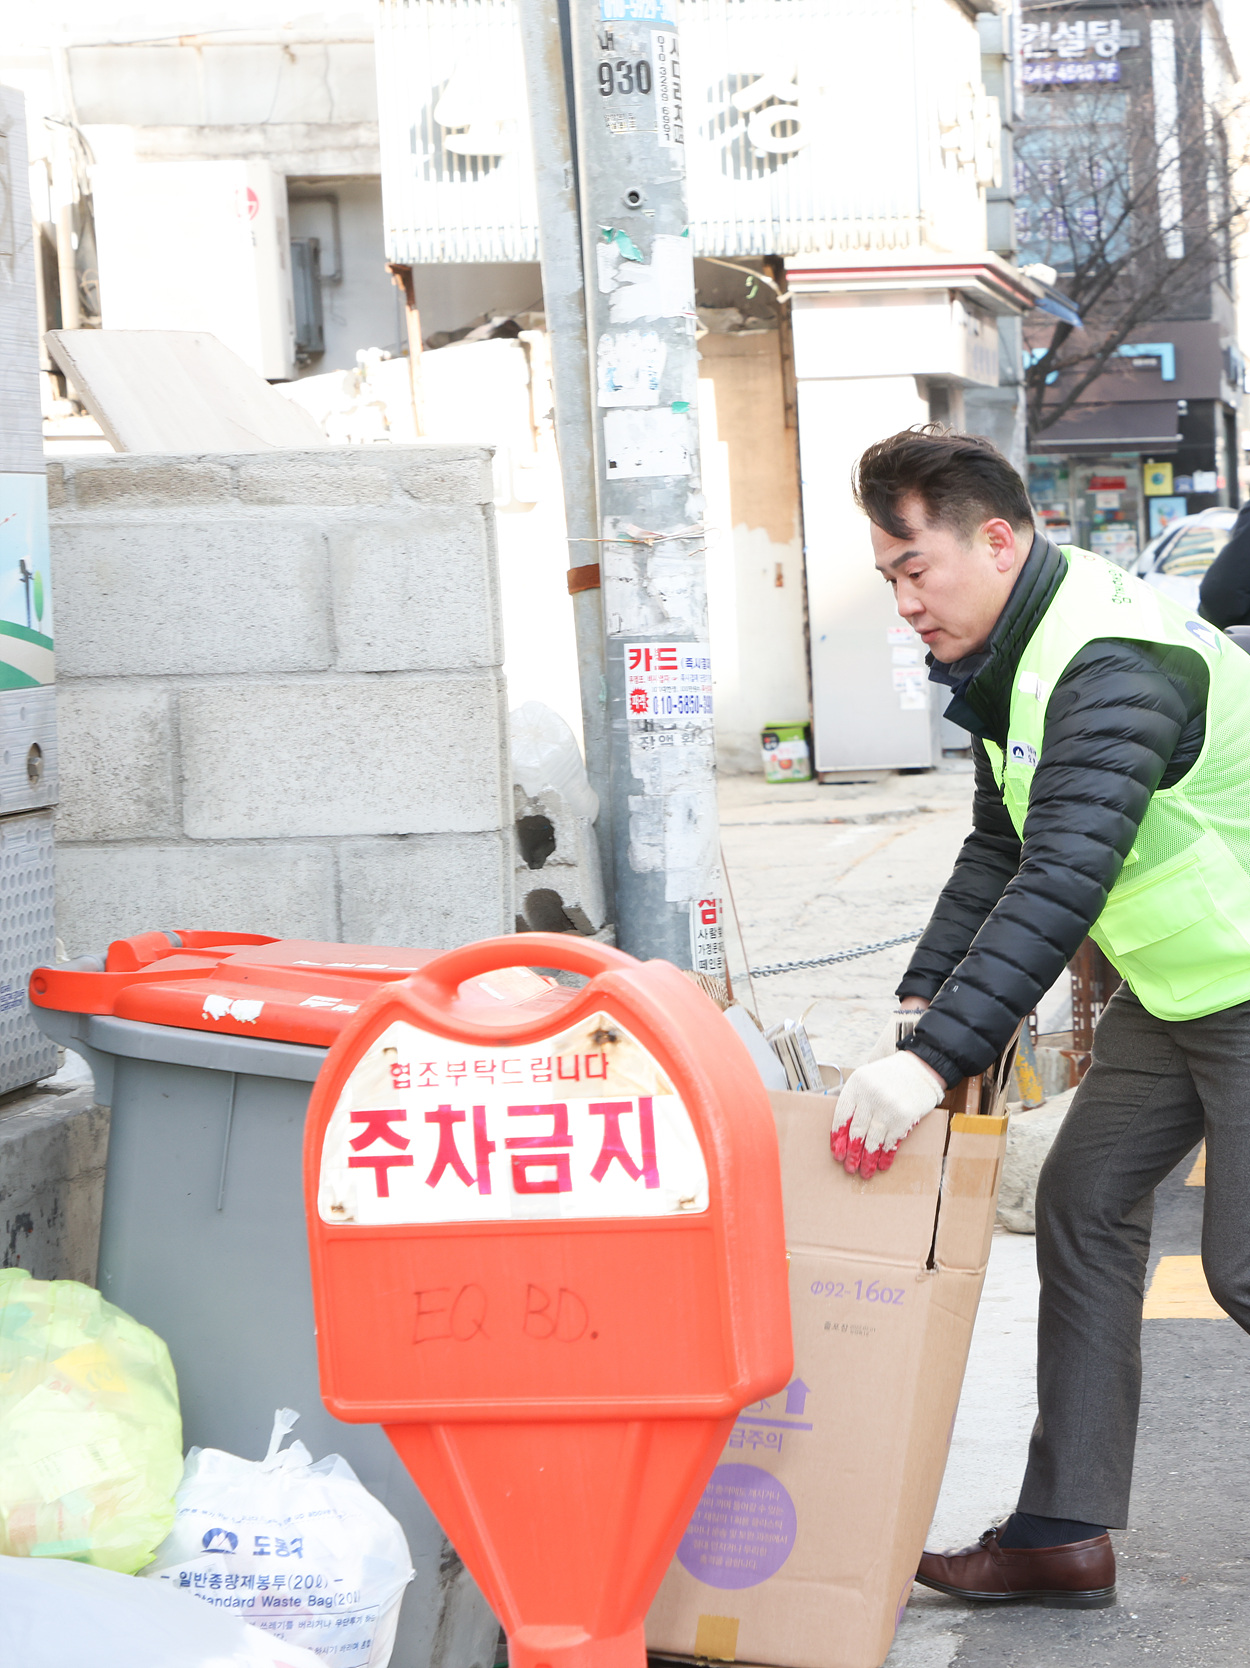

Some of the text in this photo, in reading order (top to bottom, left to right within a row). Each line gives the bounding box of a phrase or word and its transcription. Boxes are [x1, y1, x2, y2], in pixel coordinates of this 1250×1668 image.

[598, 60, 652, 96] 930
[628, 648, 678, 671] 카드
[389, 1052, 609, 1090] 협조부탁드립니다
[347, 1096, 660, 1198] 주차금지
[253, 1536, 303, 1559] 도봉구
[194, 1593, 256, 1608] tandard
[262, 1594, 301, 1608] Waste
[298, 1620, 332, 1629] 버리거나
